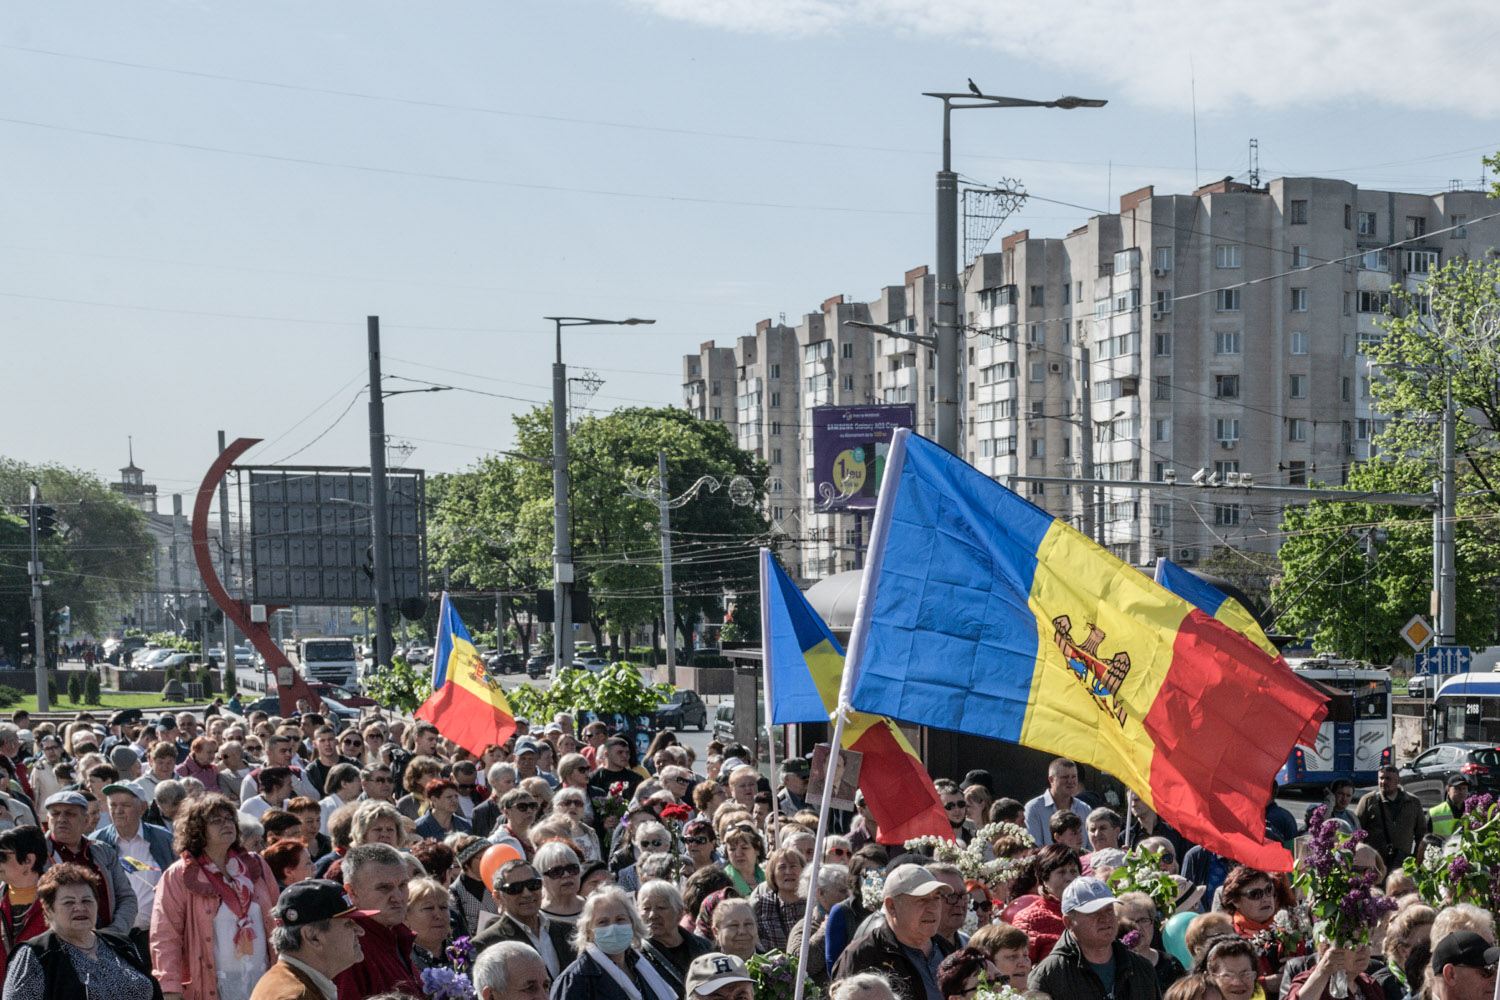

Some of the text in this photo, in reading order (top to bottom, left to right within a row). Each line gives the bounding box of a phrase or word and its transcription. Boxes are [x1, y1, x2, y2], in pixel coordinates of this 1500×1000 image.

[827, 423, 854, 431] SAMSUNG
[854, 422, 873, 431] Galaxy
[837, 458, 862, 479] 1 leu
[1466, 703, 1480, 715] 2168
[712, 957, 733, 975] H
